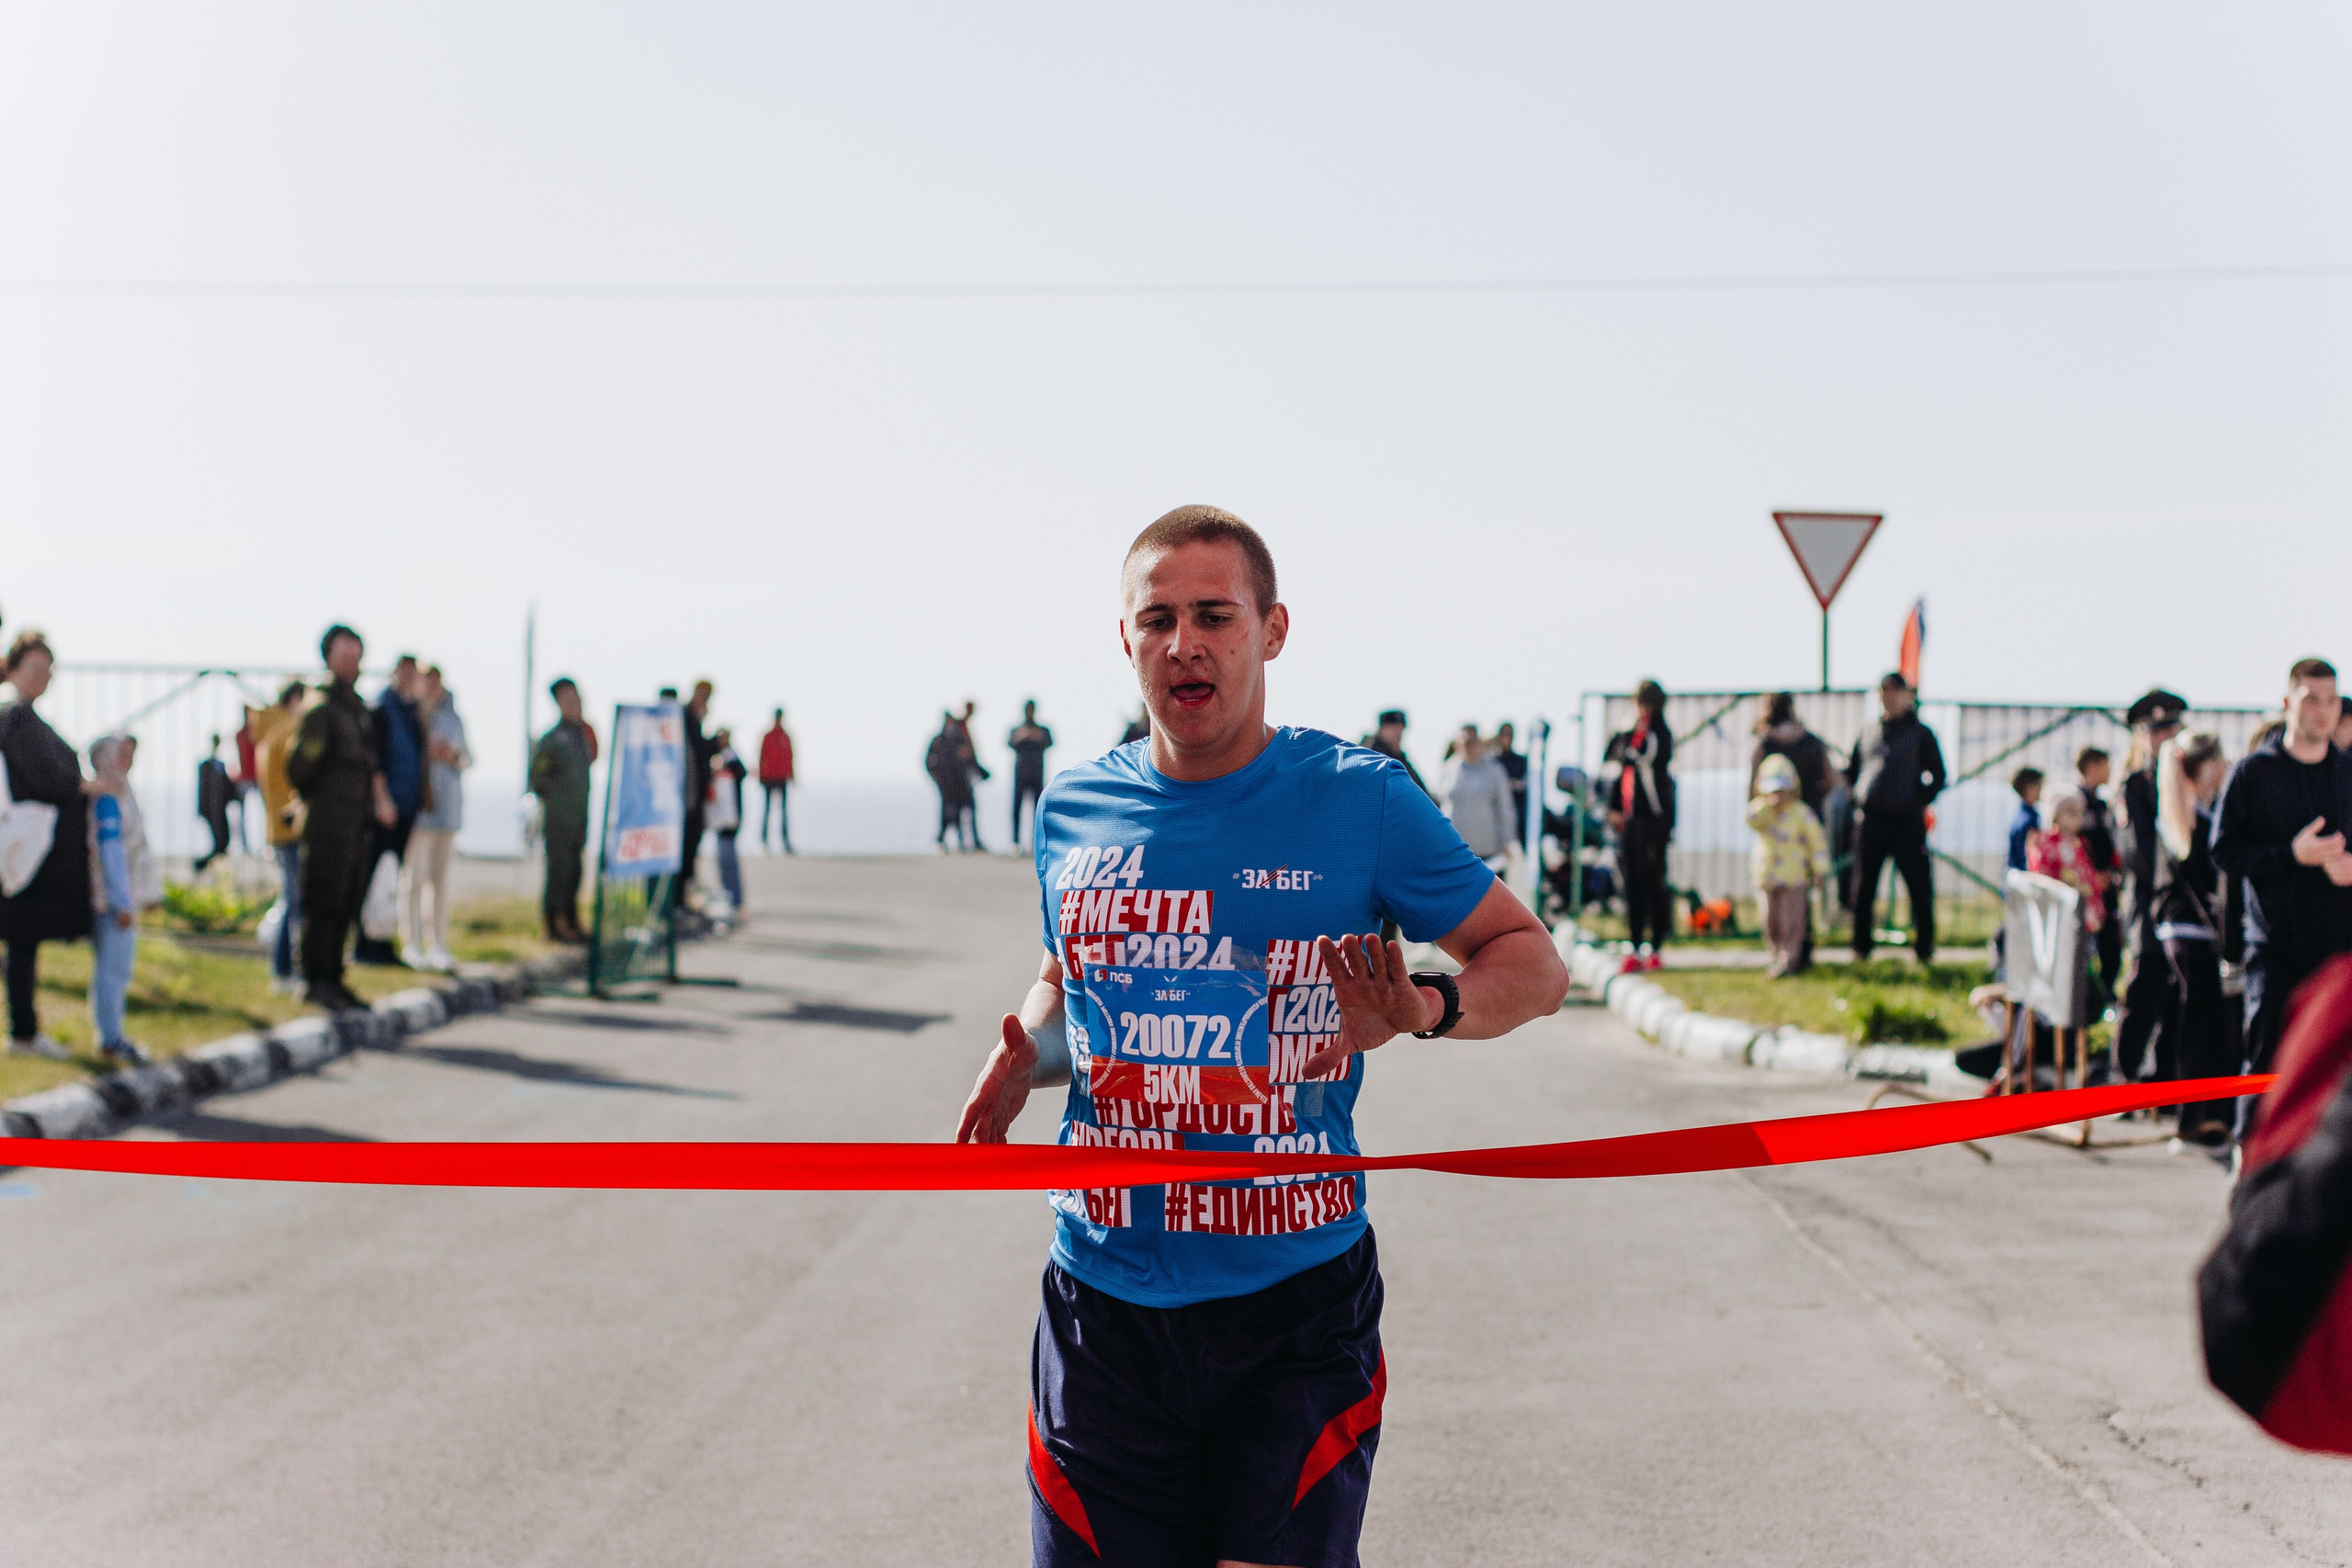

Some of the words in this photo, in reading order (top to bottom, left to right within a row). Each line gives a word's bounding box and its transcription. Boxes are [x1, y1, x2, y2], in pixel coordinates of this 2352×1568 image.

[1056, 845, 1145, 890] 2024
[1059, 889, 1212, 934] #МЕЧТА
[1109, 971, 1134, 985] ПСБ
[1120, 1011, 1231, 1060] 20072
[1164, 1176, 1356, 1235] #ЕДИНСТВО
